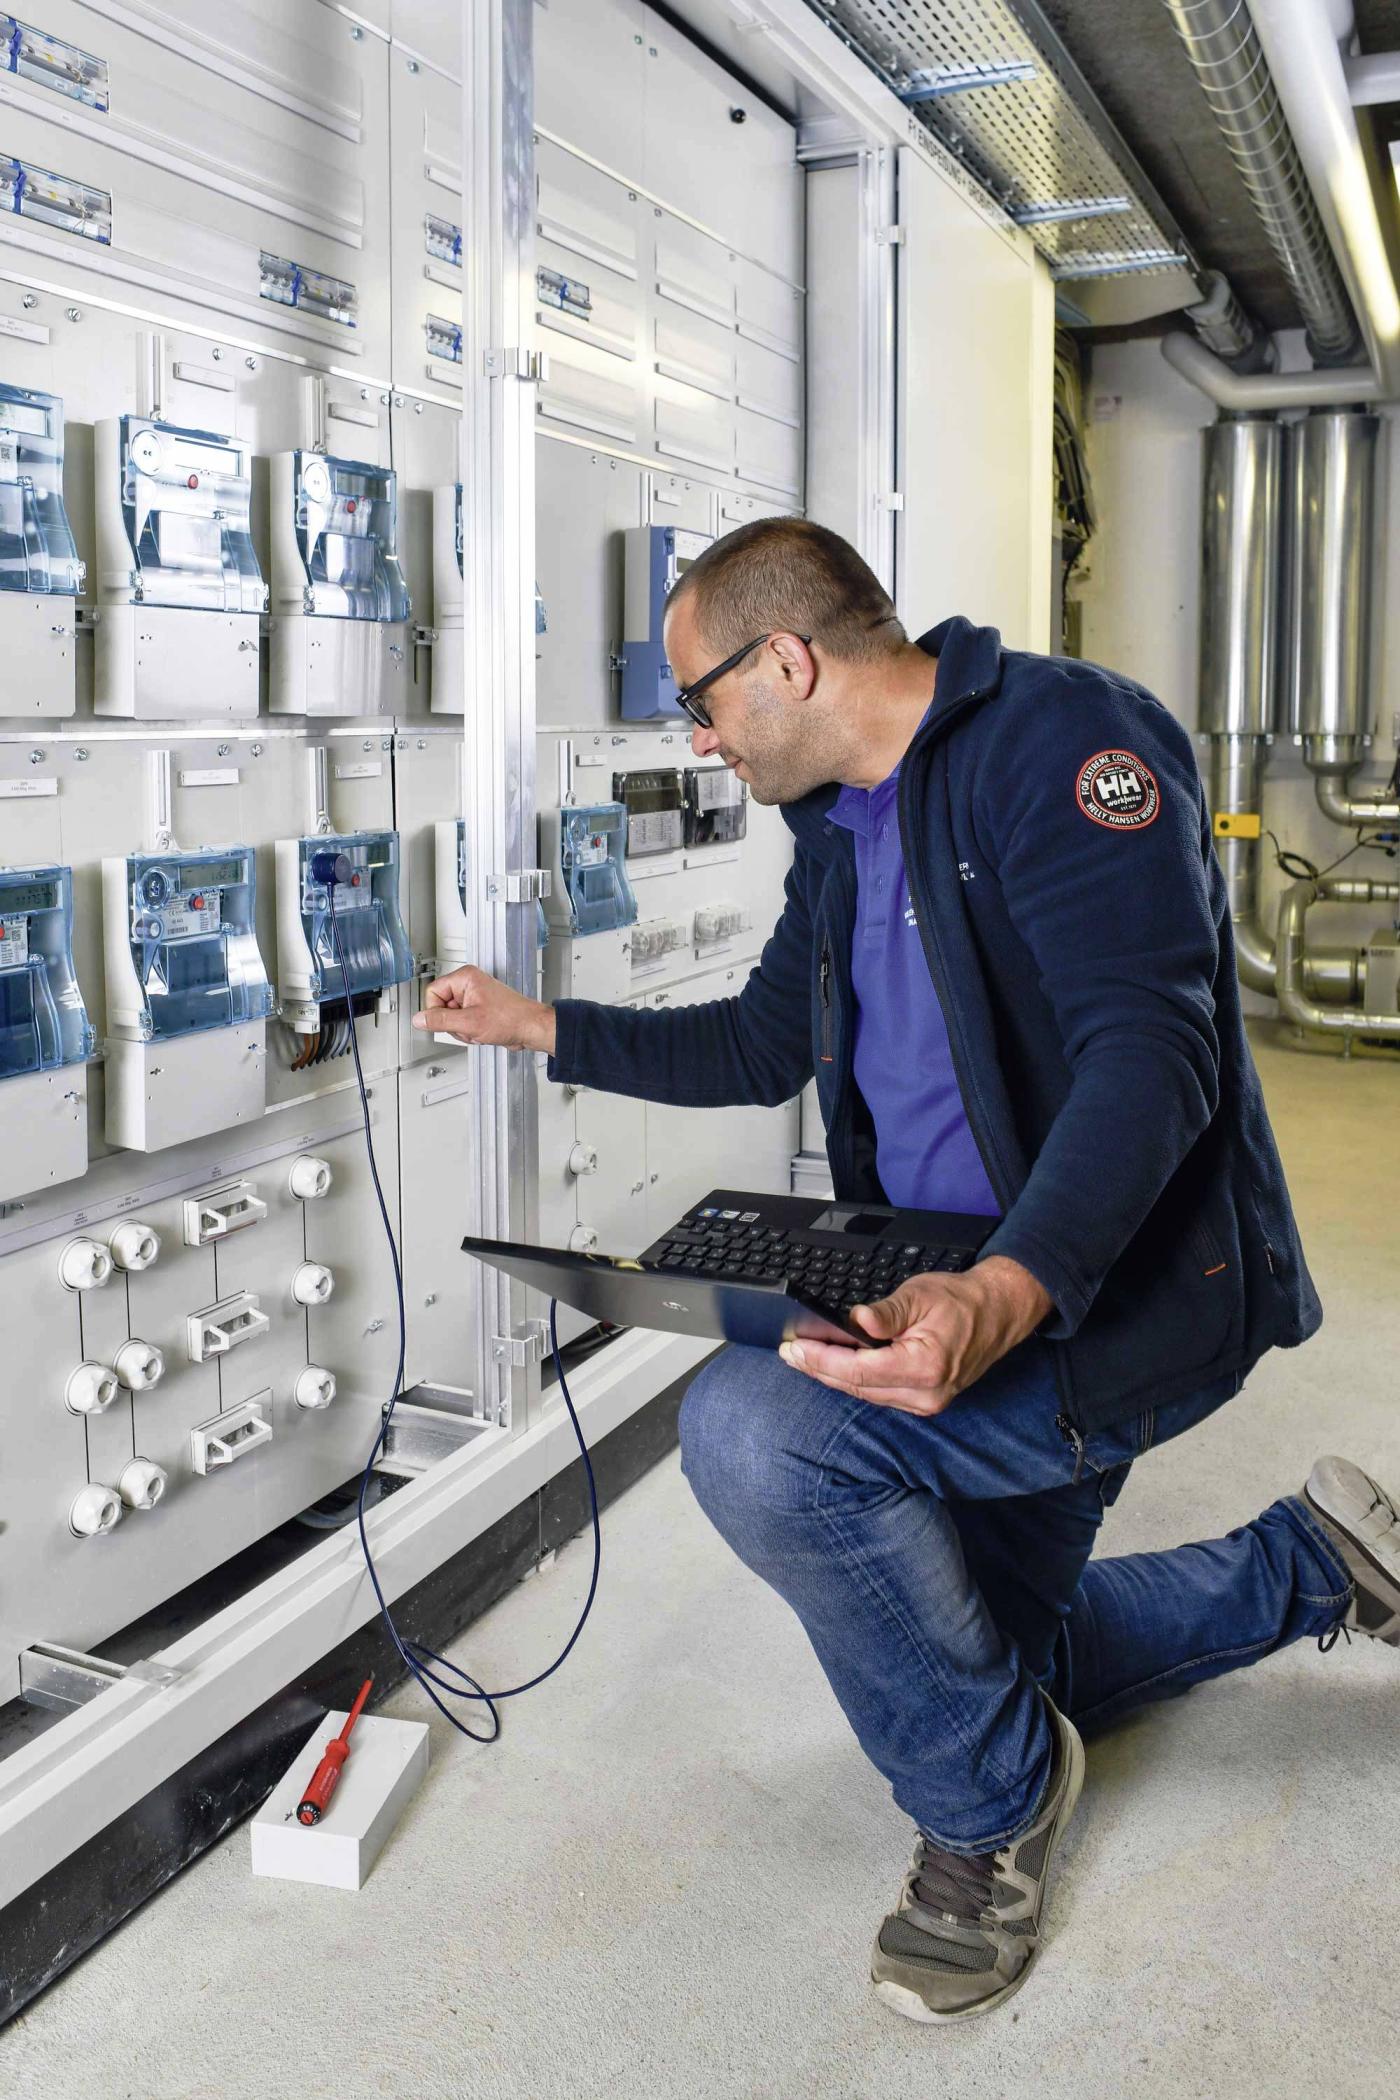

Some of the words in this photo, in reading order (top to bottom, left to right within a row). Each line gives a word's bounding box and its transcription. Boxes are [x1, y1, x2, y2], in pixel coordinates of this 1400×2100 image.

[1084, 755, 1110, 780] EXTREME
[1112, 754, 1149, 781] CONDITIONS
[1081, 780, 1090, 796] FOR
[1096, 772, 1141, 800] HH
[1086, 803, 1108, 820] HELLY
[1108, 815, 1140, 825] HANSEN
[1139, 789, 1156, 820] WORKWEAR
